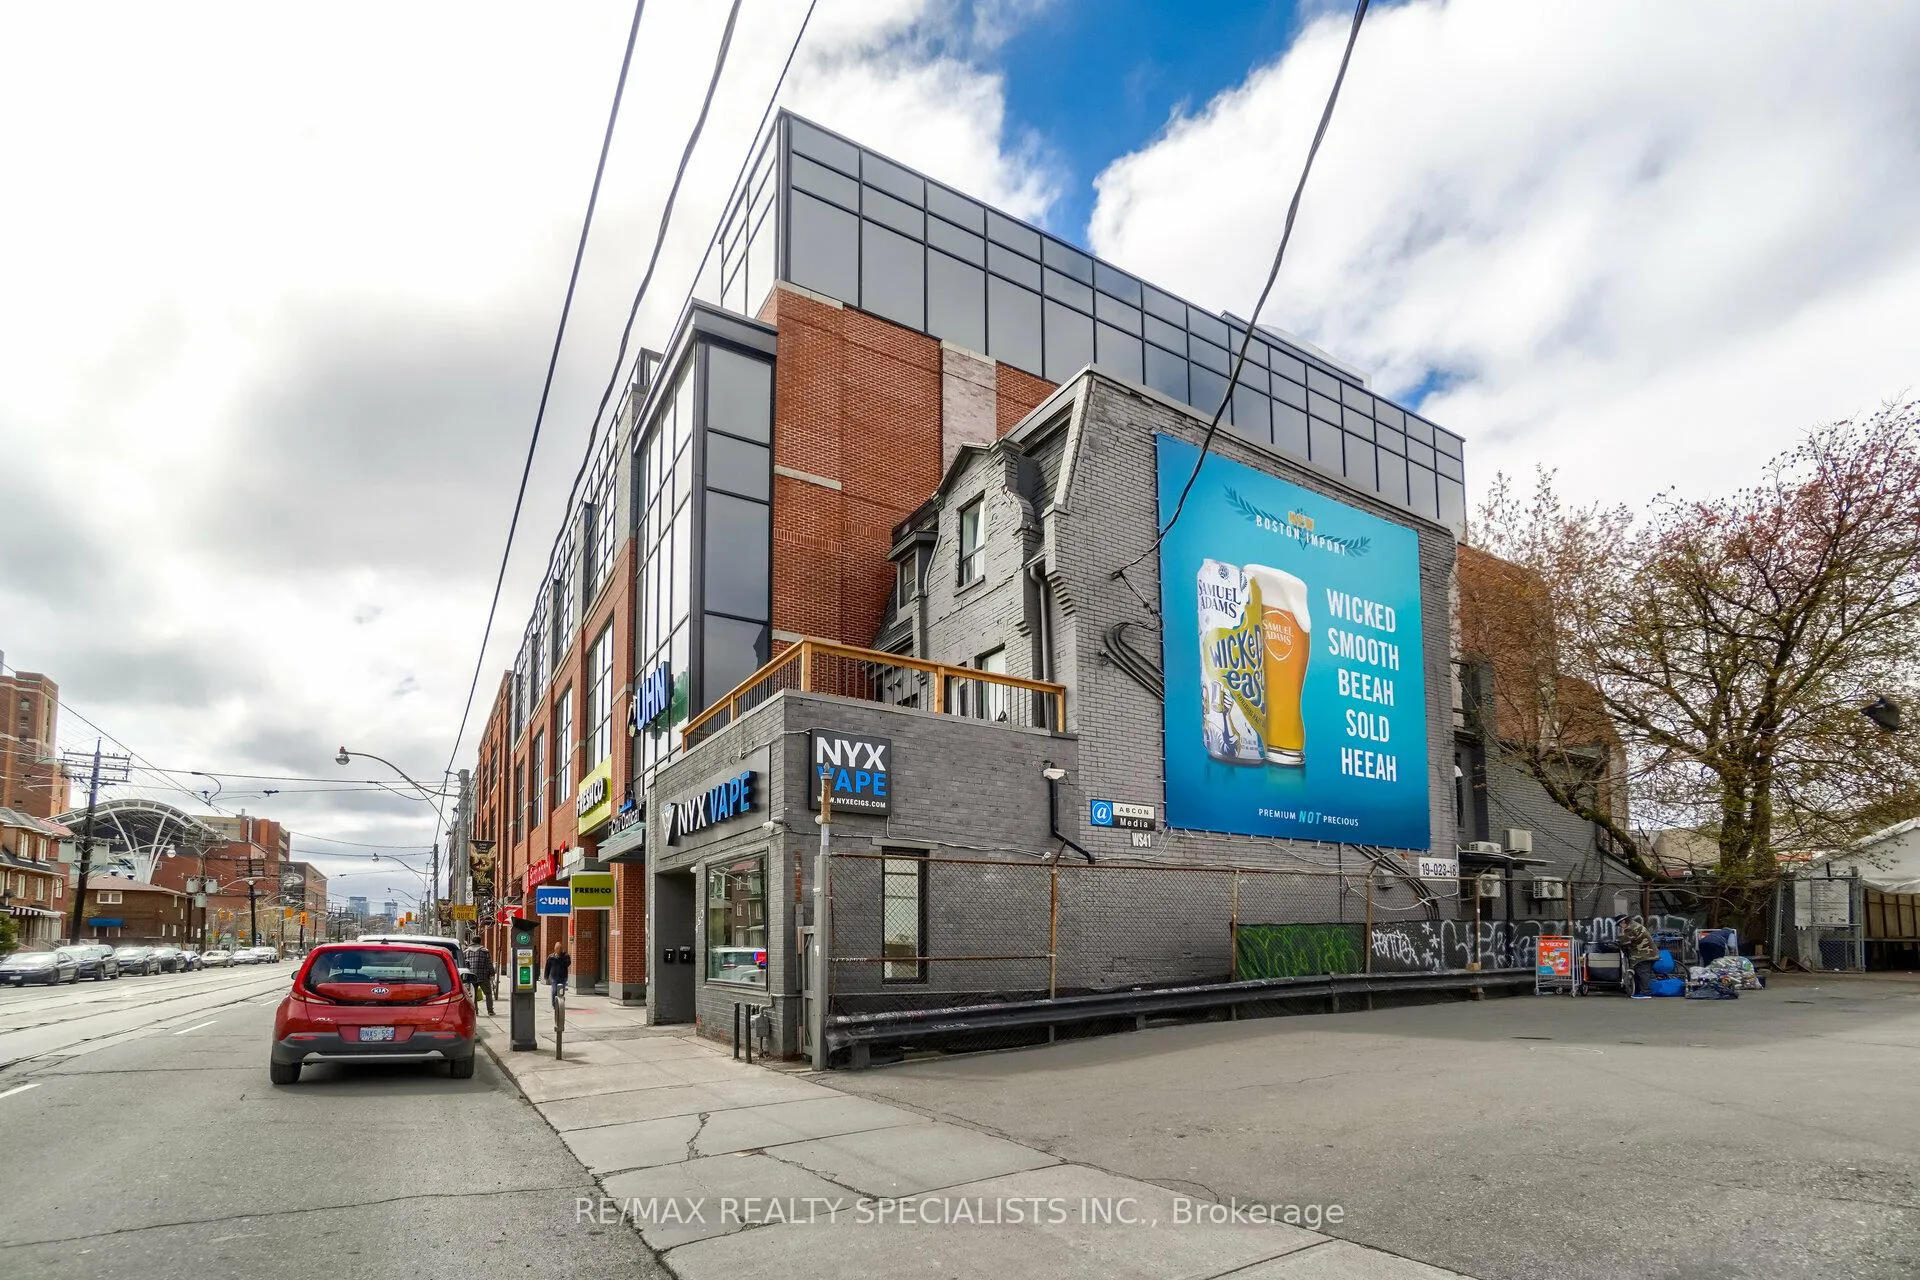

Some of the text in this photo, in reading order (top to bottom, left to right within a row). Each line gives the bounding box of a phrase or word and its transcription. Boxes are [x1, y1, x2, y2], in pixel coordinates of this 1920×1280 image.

[1256, 515, 1346, 556] BOSTON IMPORT
[1199, 579, 1241, 605] SAMUEL
[1200, 596, 1237, 619] ADAMS
[1326, 588, 1396, 633] WICKED
[1262, 619, 1294, 638] SAMUEL
[1265, 631, 1292, 646] ADAMS
[1328, 627, 1399, 671] SMOOTH
[636, 662, 670, 731] UHN
[1338, 668, 1394, 706] BEEAH
[1346, 709, 1390, 743] SOLD
[816, 737, 886, 771] NYX
[1341, 747, 1397, 782] HEEAH
[816, 764, 887, 797] VAPE
[677, 771, 754, 836] NYX VAPE
[816, 796, 887, 809] WW.NYXECIGS.COM
[1119, 806, 1149, 815] ABCON
[1258, 808, 1359, 827] PREMIUM NOT PRECIOUS
[1119, 818, 1148, 828] Media
[548, 897, 569, 905] UHN
